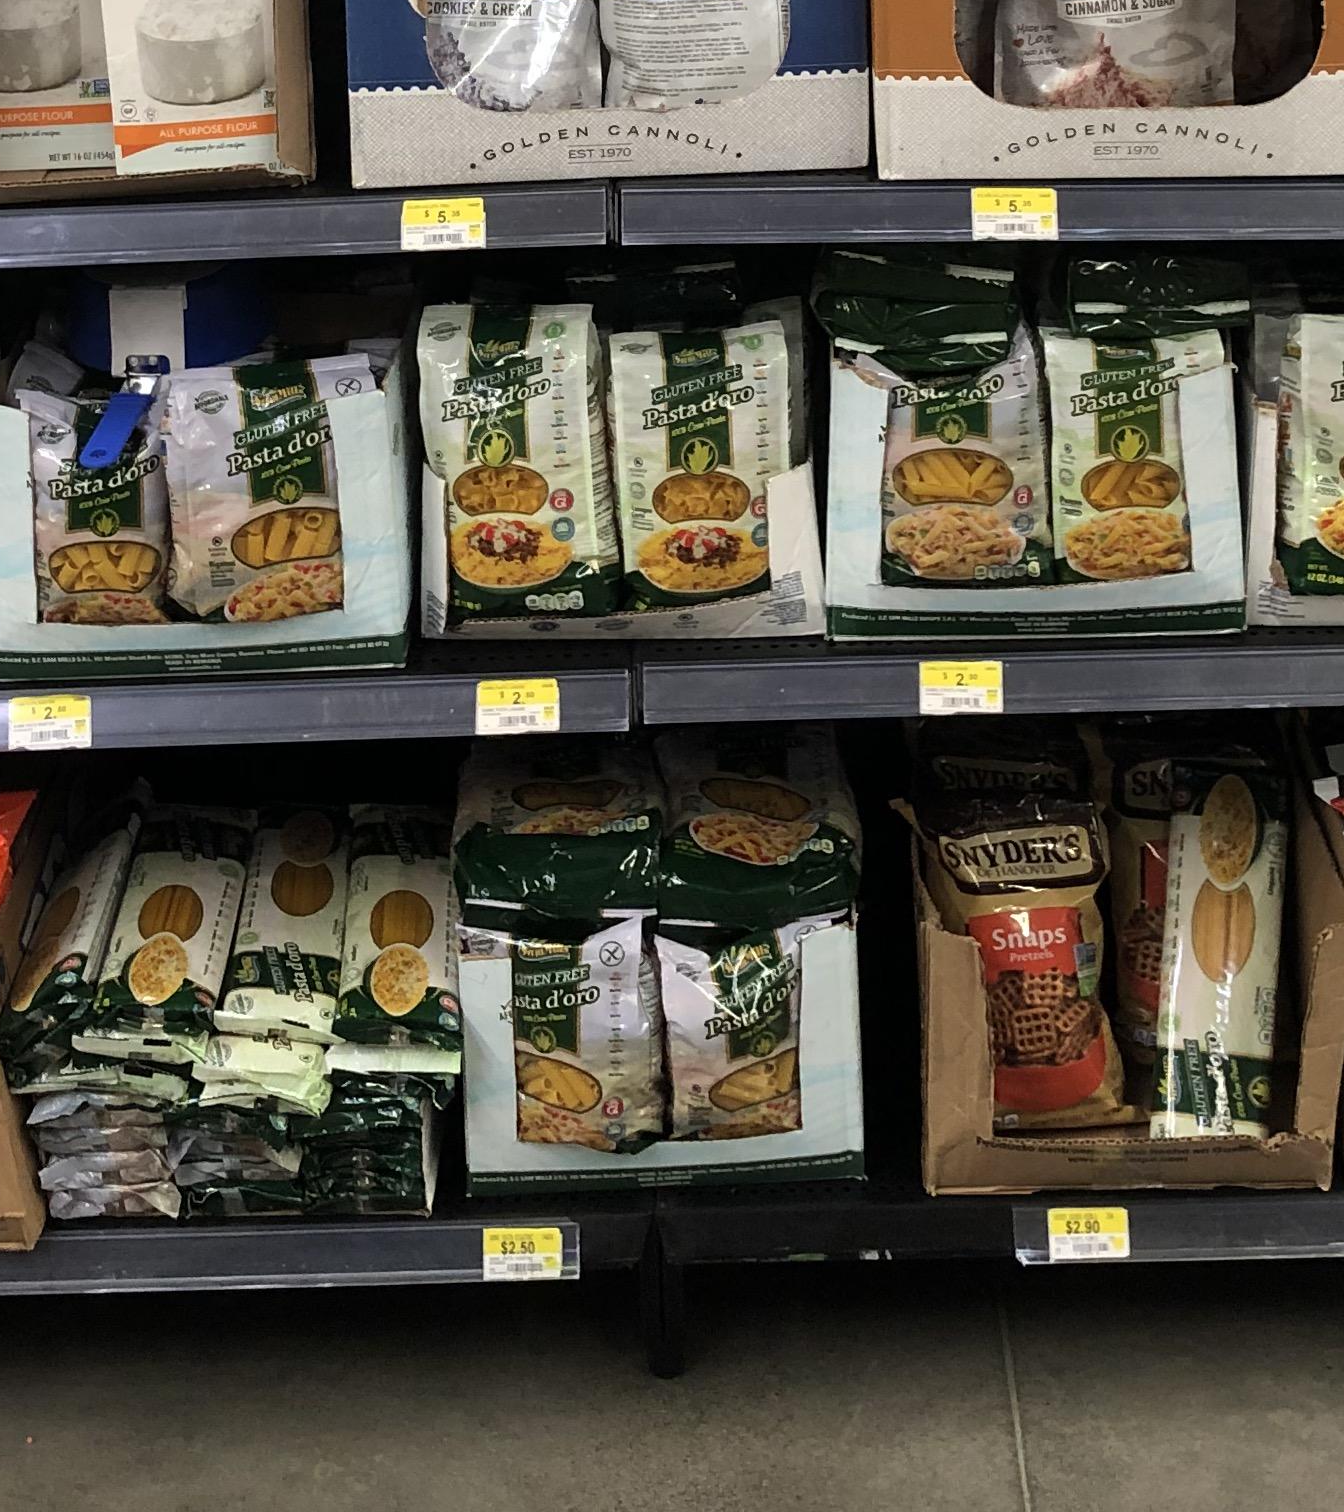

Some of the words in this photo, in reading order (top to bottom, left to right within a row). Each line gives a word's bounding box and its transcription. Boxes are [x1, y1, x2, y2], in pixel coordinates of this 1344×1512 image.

[484, 123, 592, 162] GOLDEN
[608, 123, 730, 156] CANNOLI
[568, 148, 595, 159] EST
[598, 147, 632, 159] 1970
[643, 405, 696, 430] Pasta
[992, 925, 1067, 952] Snaps
[1065, 1220, 1101, 1235] $2.90
